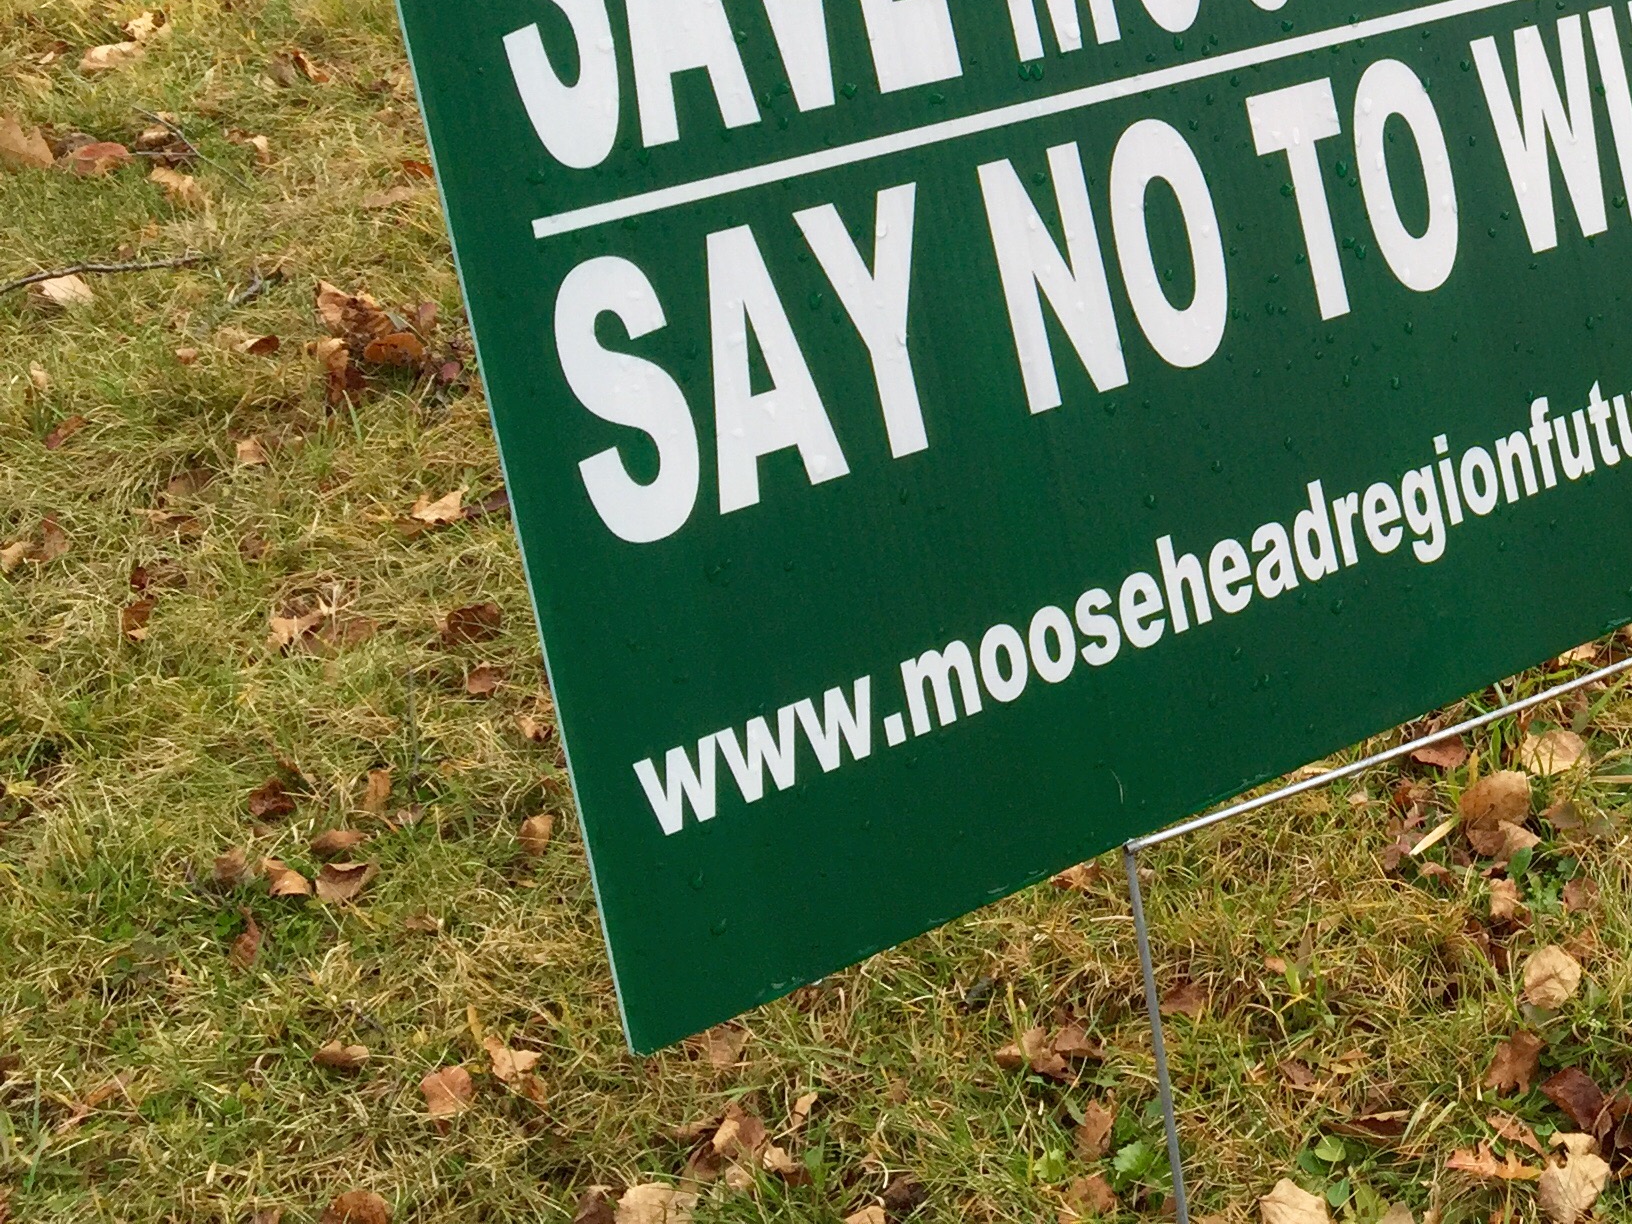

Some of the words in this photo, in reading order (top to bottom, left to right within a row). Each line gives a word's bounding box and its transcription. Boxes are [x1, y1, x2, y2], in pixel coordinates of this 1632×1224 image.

[554, 181, 929, 544] SAY
[976, 118, 1229, 415] NO
[1245, 58, 1459, 321] TO
